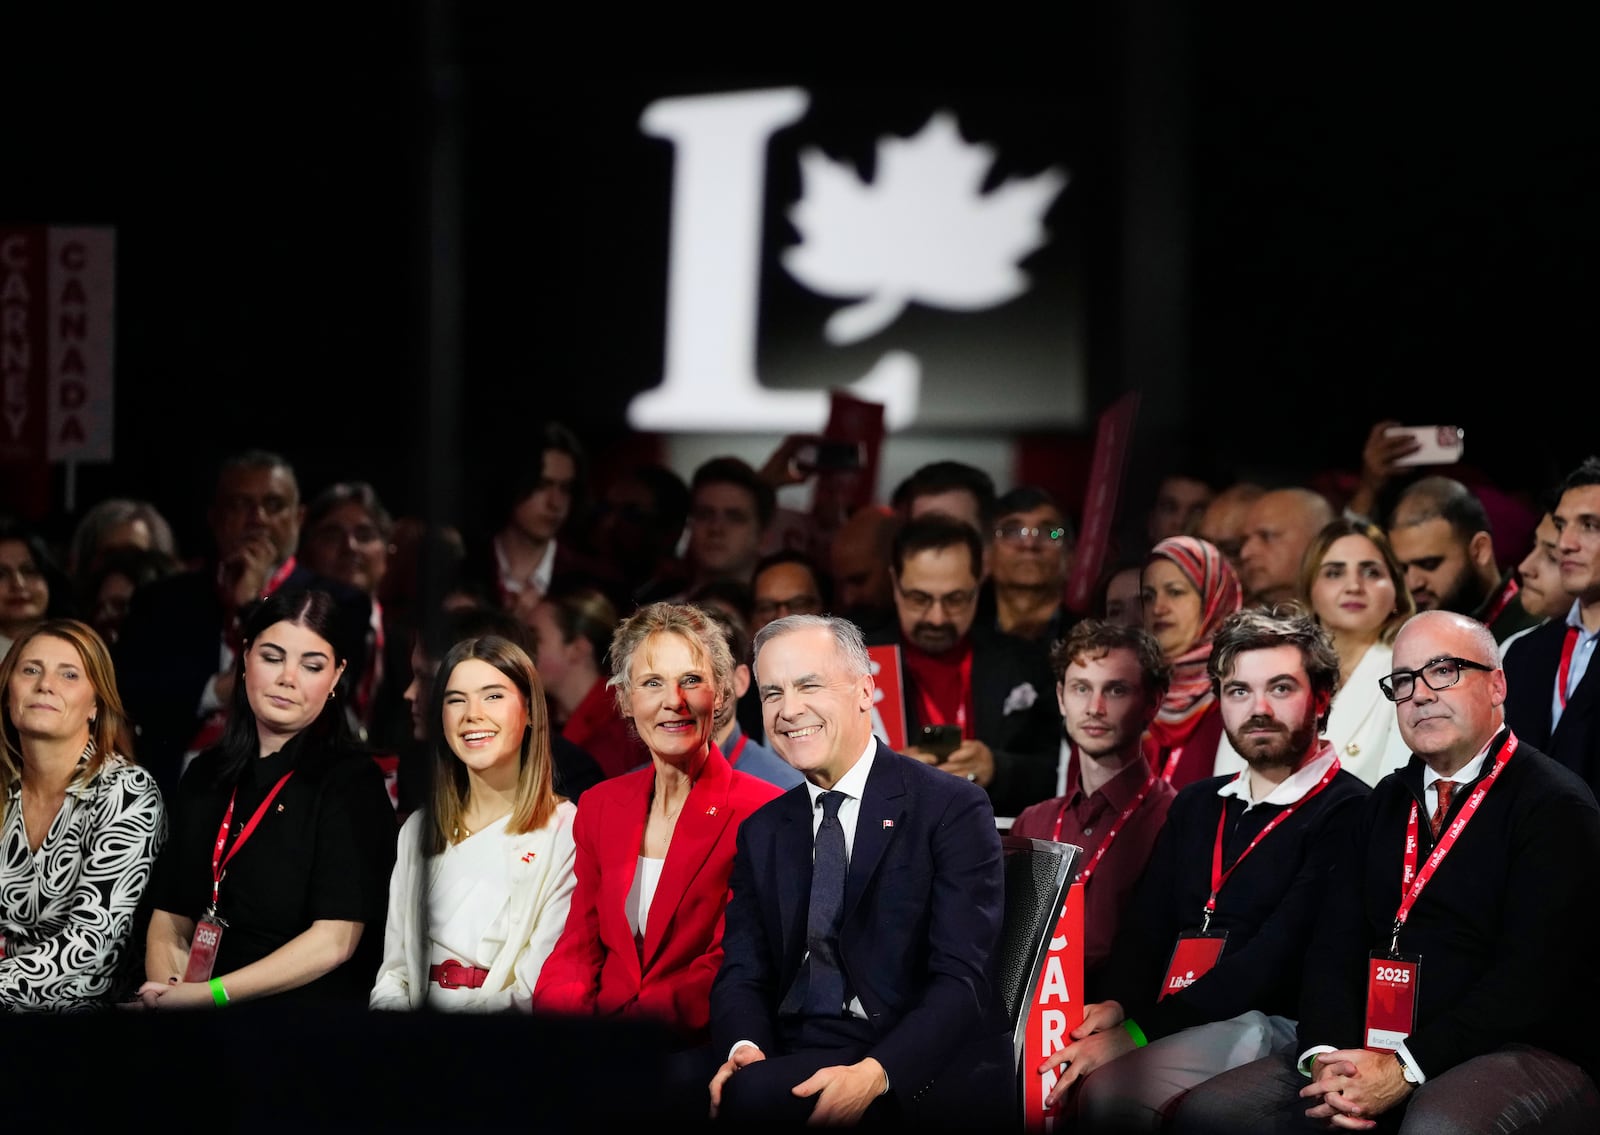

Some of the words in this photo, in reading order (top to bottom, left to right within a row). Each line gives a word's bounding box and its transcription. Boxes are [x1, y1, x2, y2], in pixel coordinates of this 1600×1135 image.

[1, 233, 31, 442] CARNEY
[60, 240, 86, 443] CANADA
[197, 929, 218, 947] 2025
[1039, 904, 1070, 1134] ARN
[1376, 966, 1410, 983] 2025
